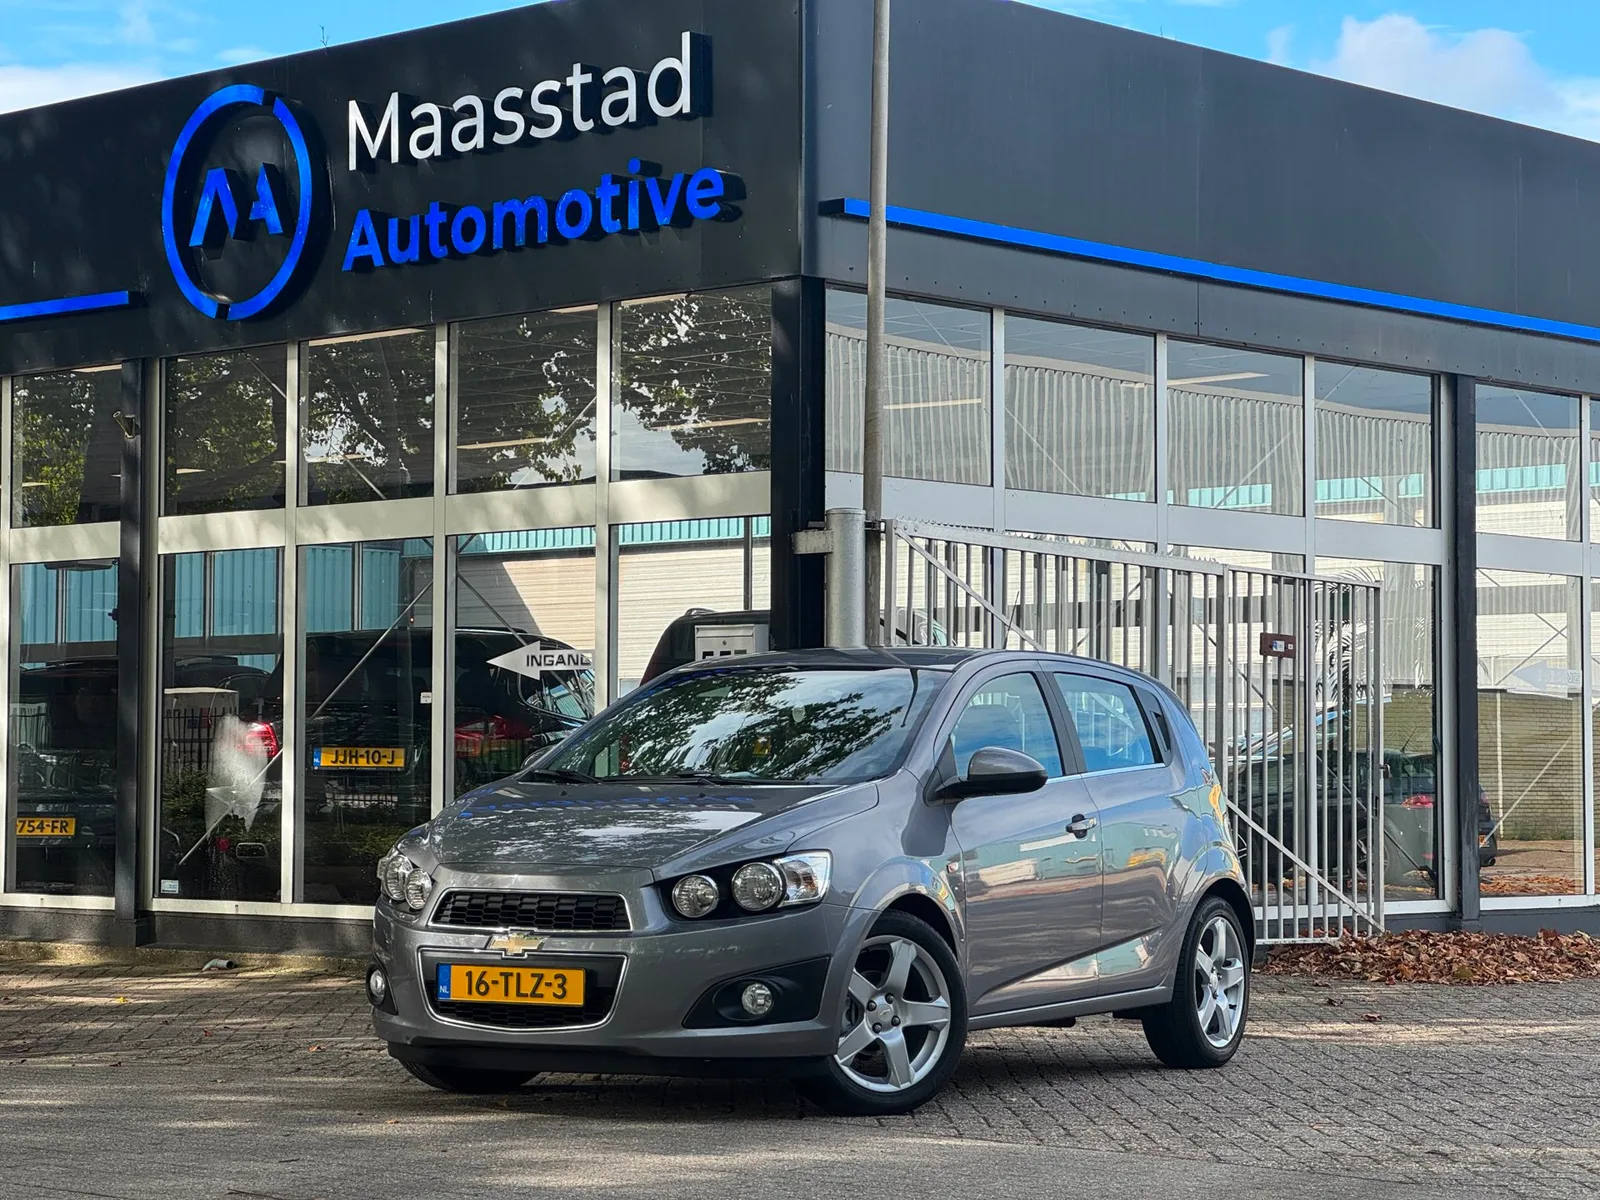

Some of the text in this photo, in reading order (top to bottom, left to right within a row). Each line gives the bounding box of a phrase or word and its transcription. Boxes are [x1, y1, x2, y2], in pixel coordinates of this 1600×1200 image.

[348, 31, 691, 171] Maasstad
[342, 157, 724, 271] Automotive
[331, 749, 395, 764] JJH-10-J
[439, 970, 567, 999] NL 16-TLZ-3
